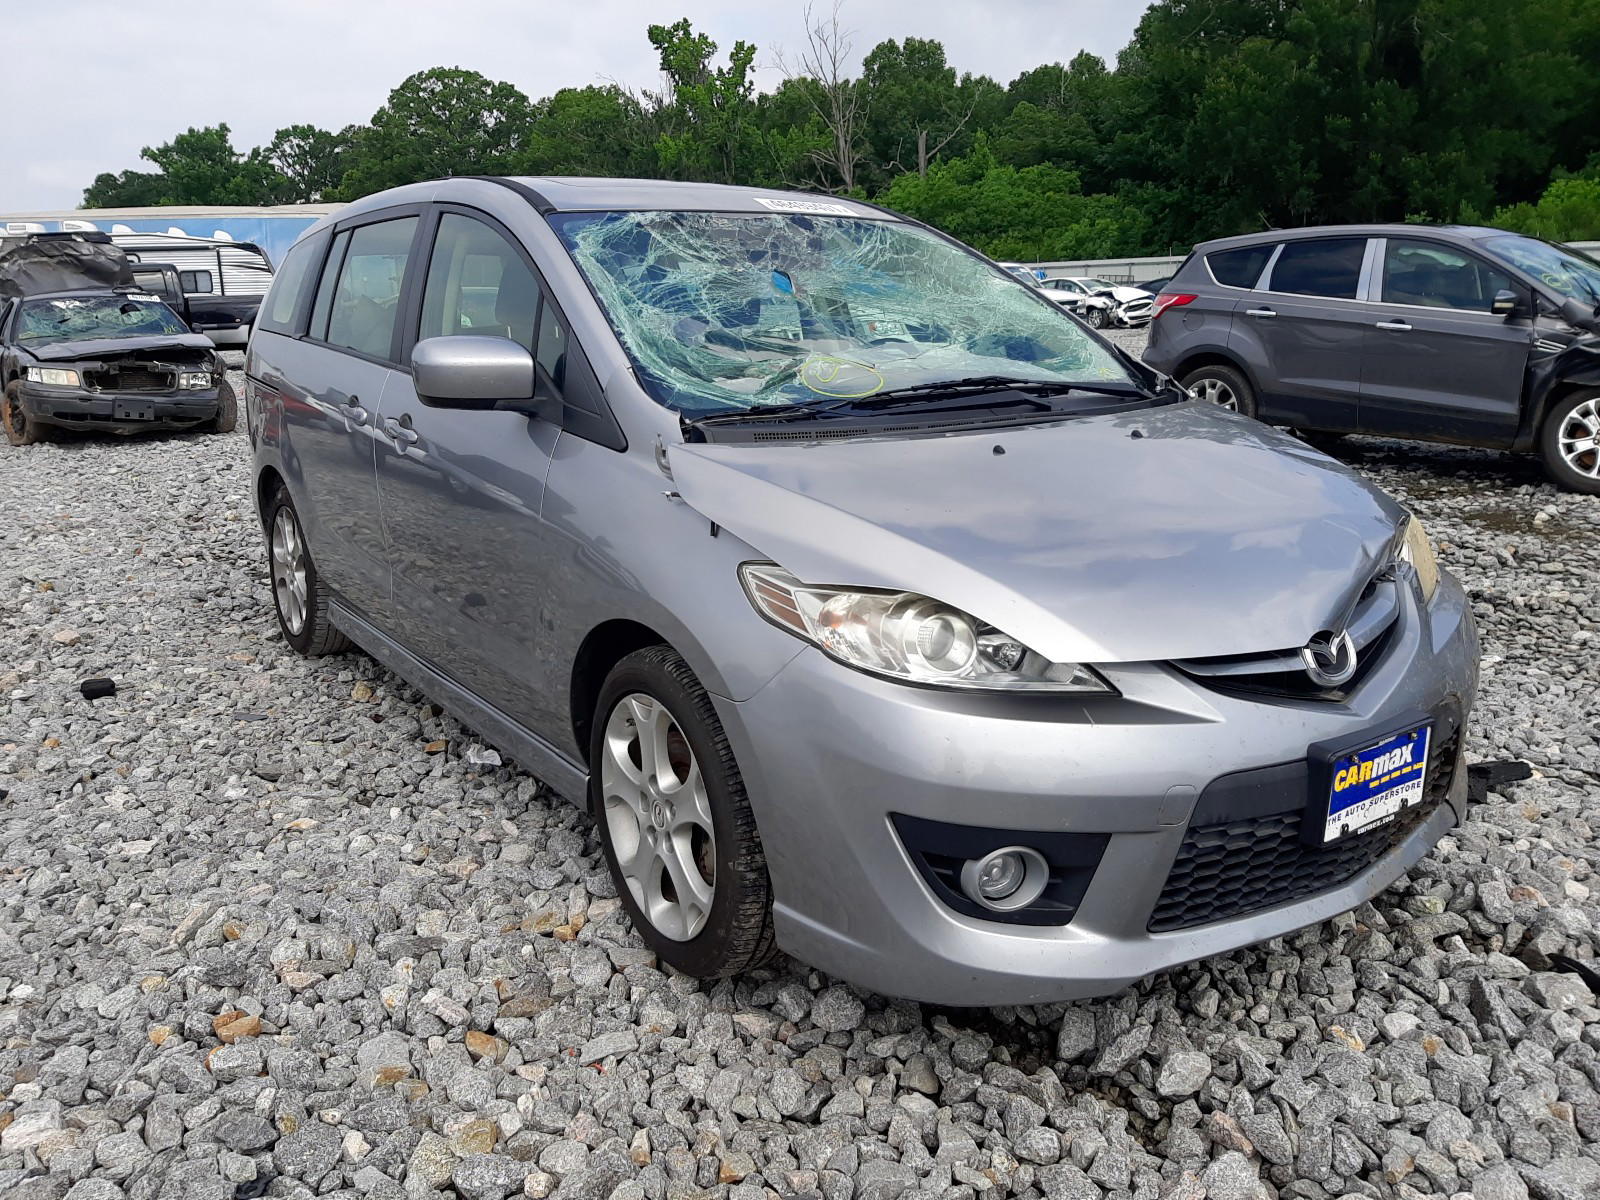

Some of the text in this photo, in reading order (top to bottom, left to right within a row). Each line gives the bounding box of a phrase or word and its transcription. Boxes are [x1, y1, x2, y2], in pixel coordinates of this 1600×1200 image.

[1328, 781, 1421, 826] THE AUTO SUPERSTORE
